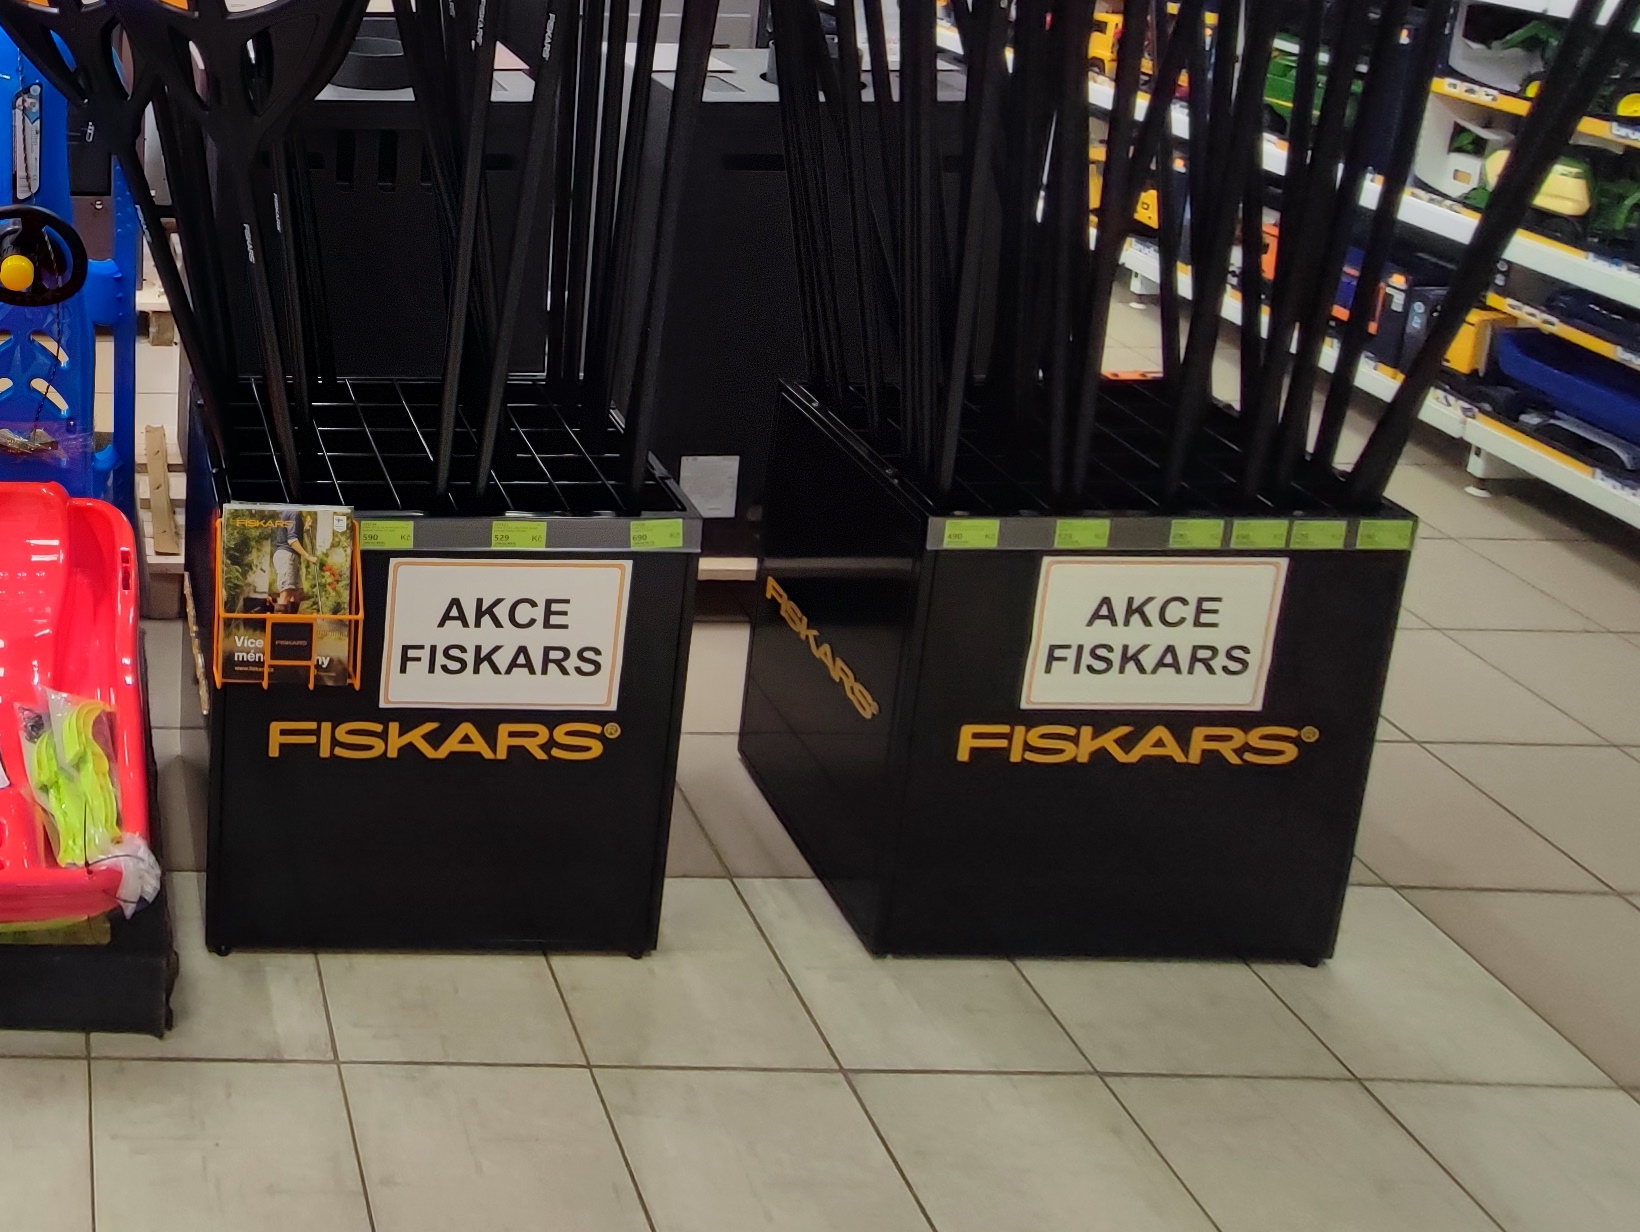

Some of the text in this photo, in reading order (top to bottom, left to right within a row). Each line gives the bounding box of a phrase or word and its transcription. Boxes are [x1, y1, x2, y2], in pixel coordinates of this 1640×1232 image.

[541, 13, 556, 62] FISKARS
[235, 519, 295, 528] FISKARS
[362, 532, 411, 541] 590 Kč
[494, 533, 543, 542] 529 Kč
[632, 533, 648, 541] 690
[437, 596, 571, 630] AKCE
[1085, 596, 1224, 628] AKCE
[234, 635, 264, 648] Více
[399, 643, 604, 677] FISKARS
[1043, 643, 1253, 677] FISKARS
